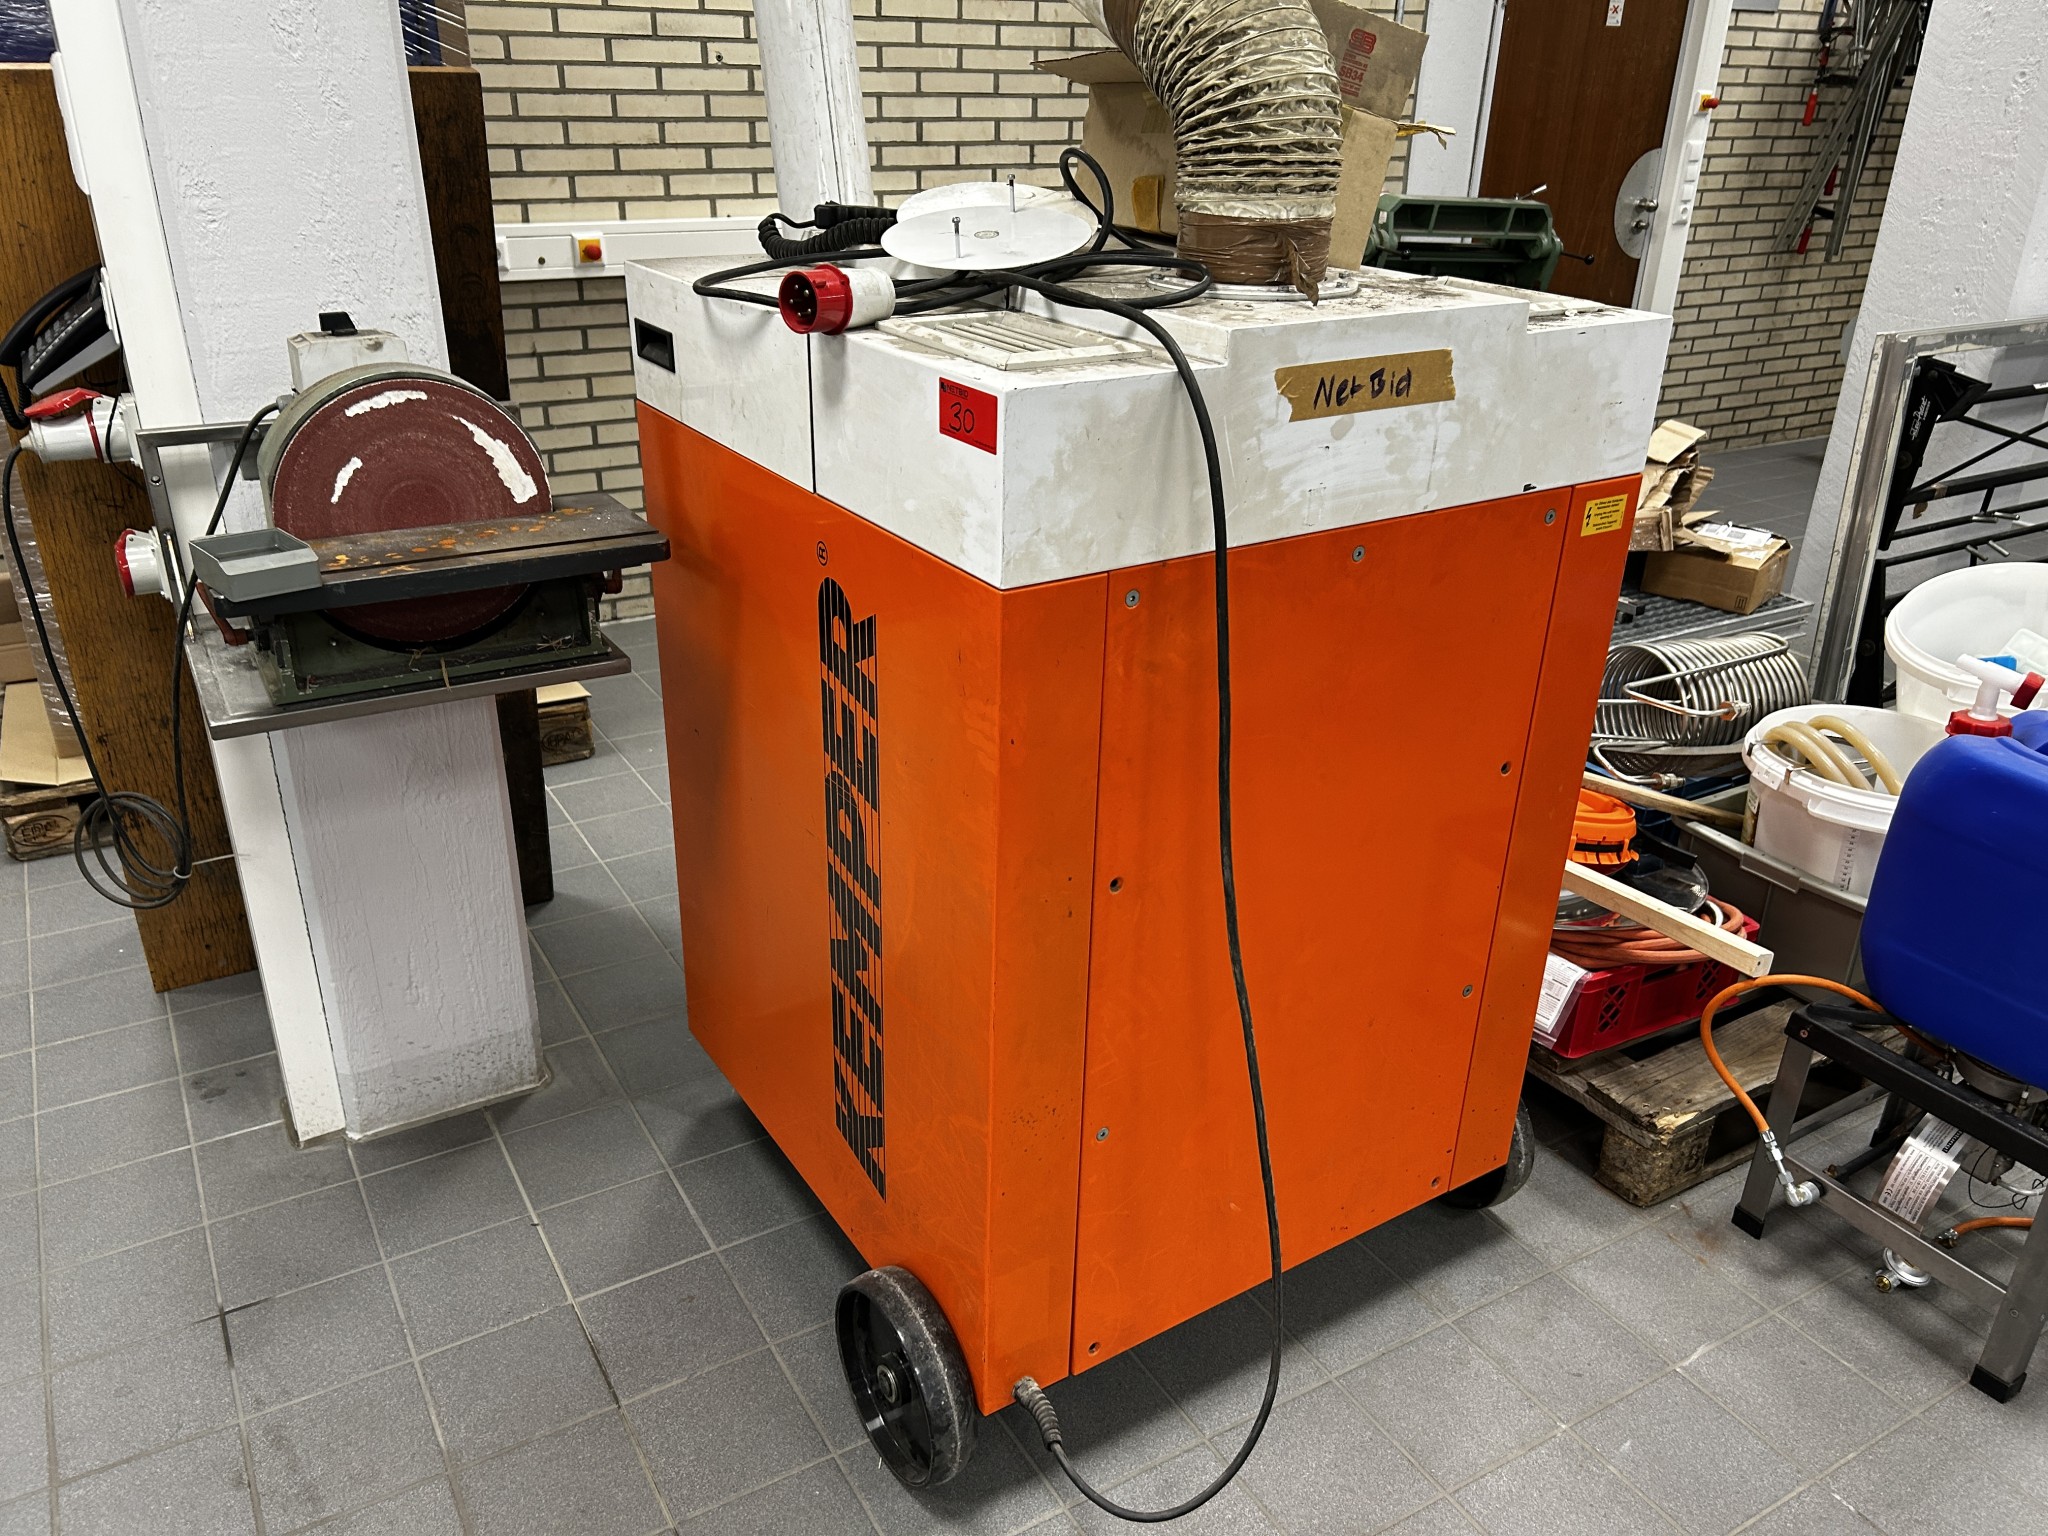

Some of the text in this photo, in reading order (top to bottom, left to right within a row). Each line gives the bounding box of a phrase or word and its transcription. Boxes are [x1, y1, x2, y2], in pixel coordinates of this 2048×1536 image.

[1339, 65, 1364, 83] SB34
[947, 384, 969, 398] NETBID
[949, 402, 974, 433] 30
[817, 577, 887, 1202] KEMPER
